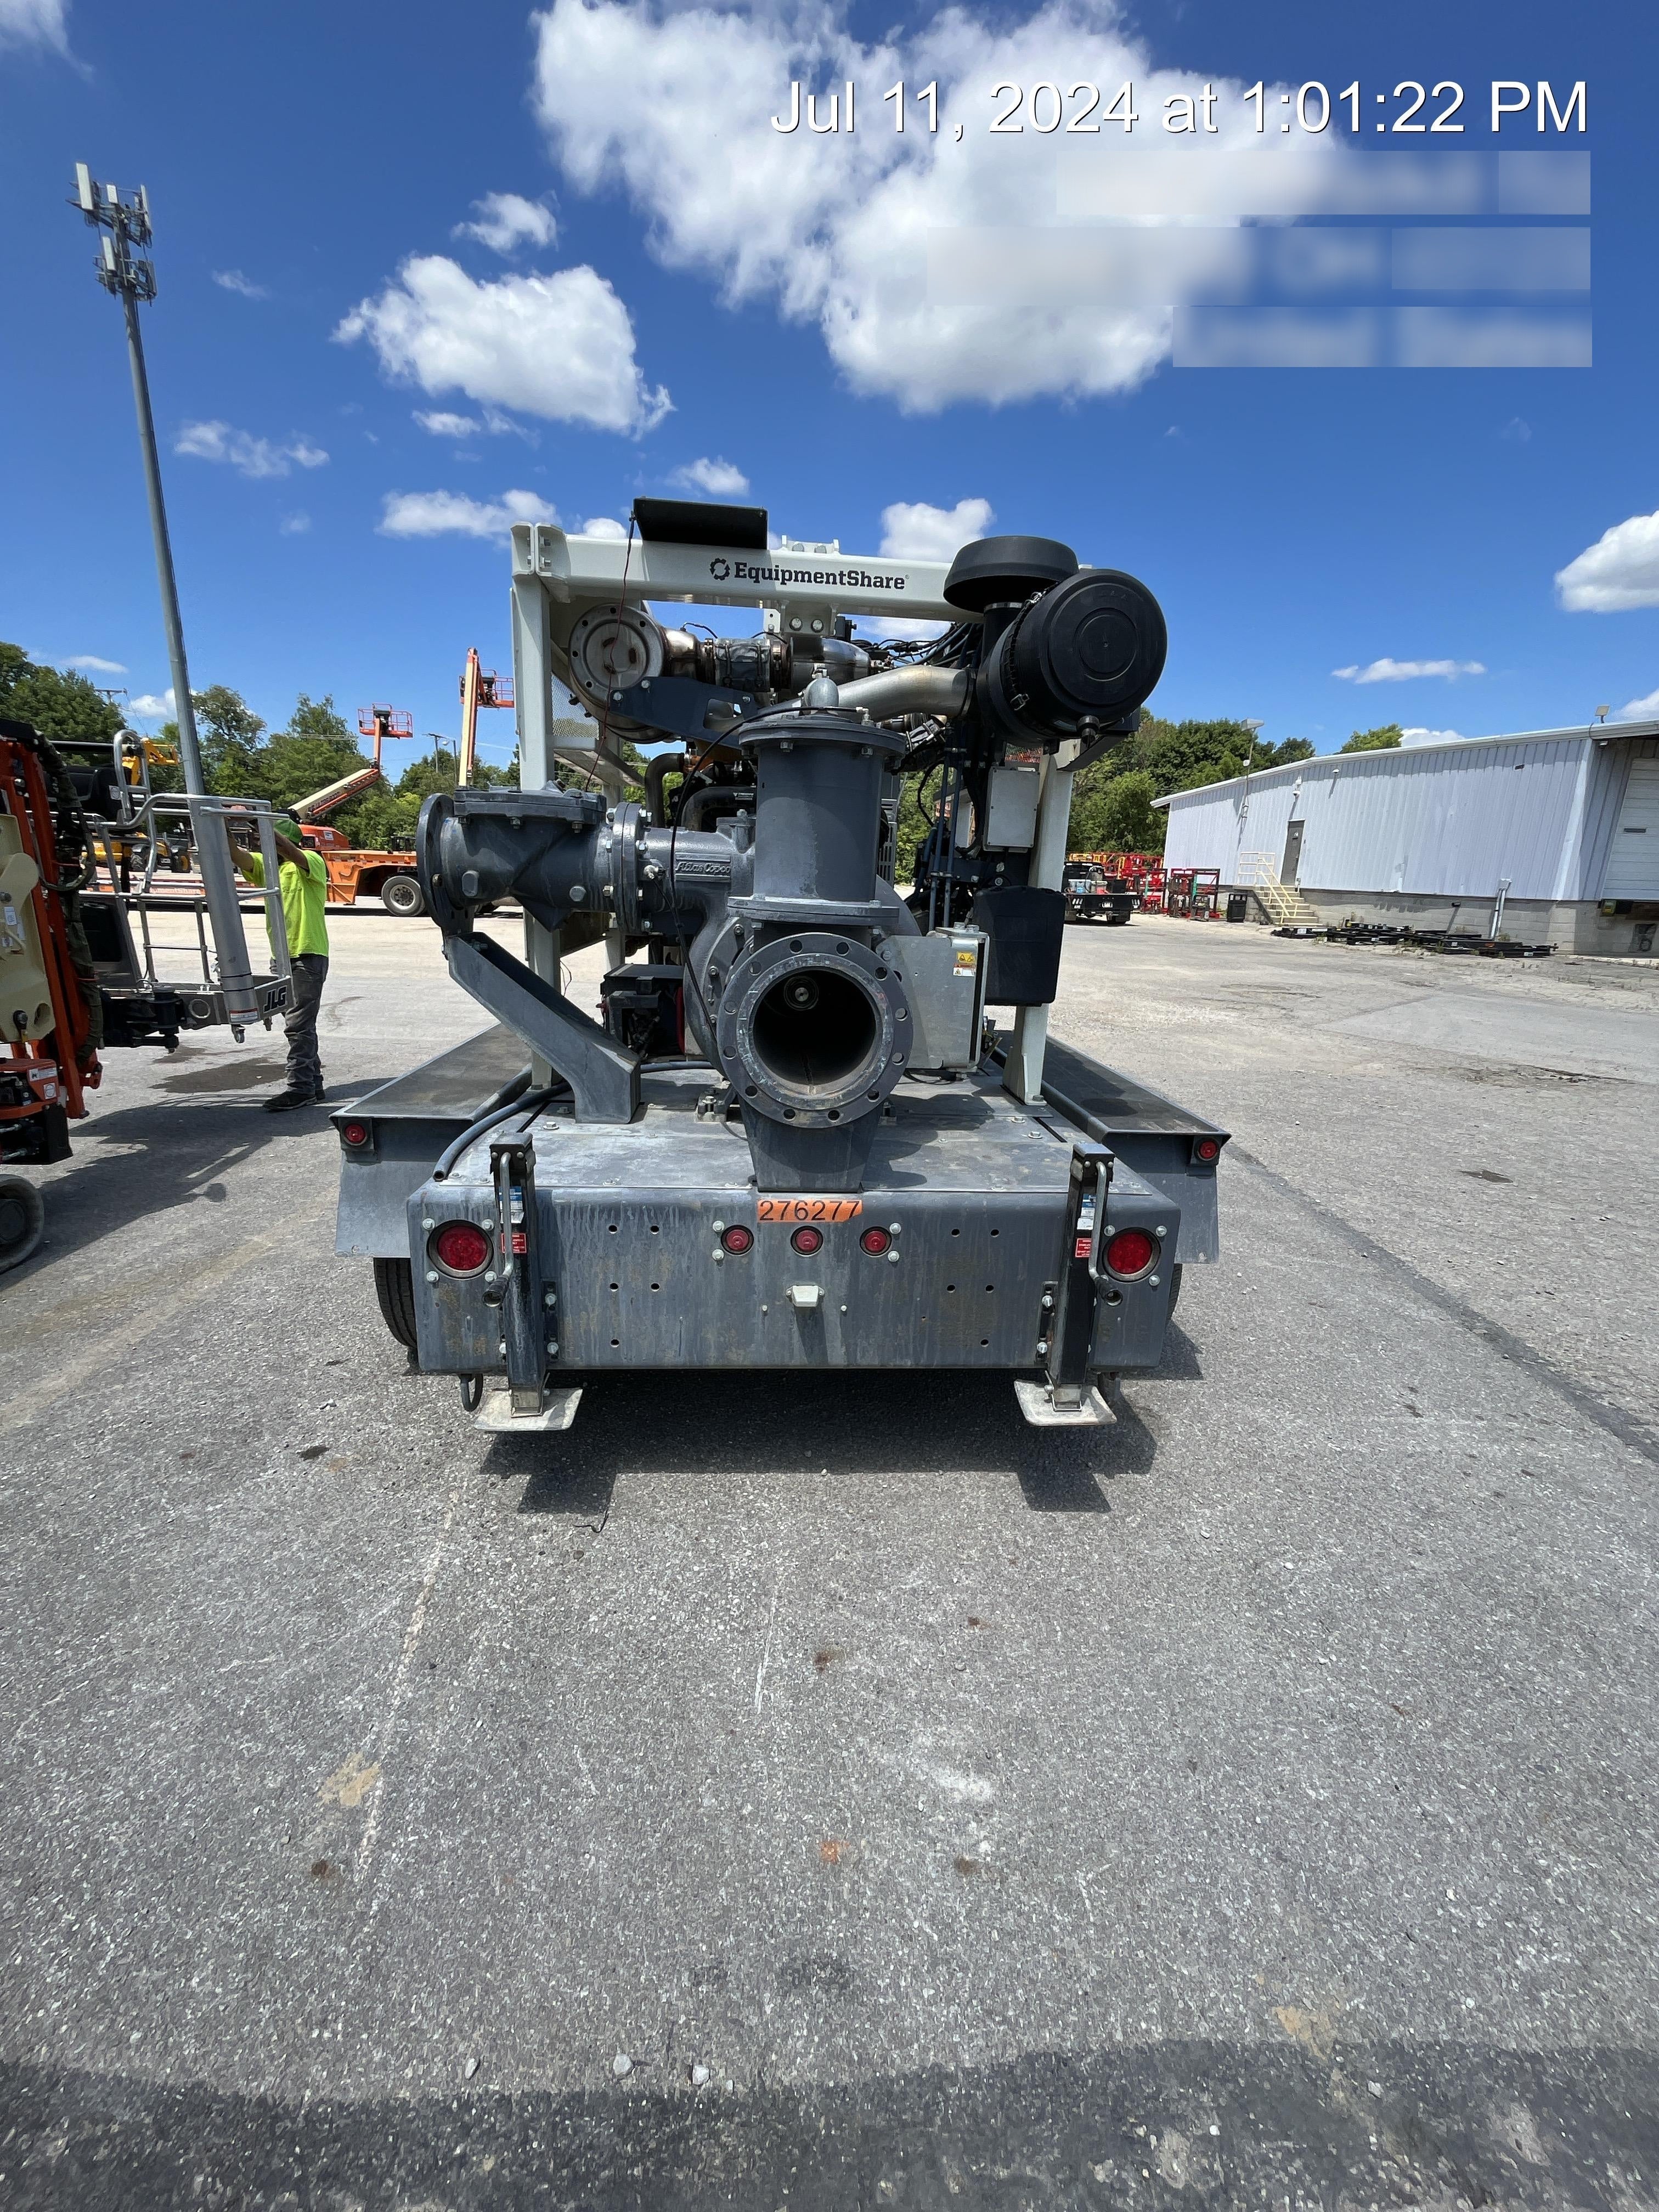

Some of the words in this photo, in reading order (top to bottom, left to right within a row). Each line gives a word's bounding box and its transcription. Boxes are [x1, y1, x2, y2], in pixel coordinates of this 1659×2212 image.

[734, 561, 905, 590] EquipmentShare
[675, 861, 703, 872] Atlas
[703, 862, 731, 873] Copco
[263, 985, 287, 1013] JLG
[759, 1200, 860, 1221] 276277
